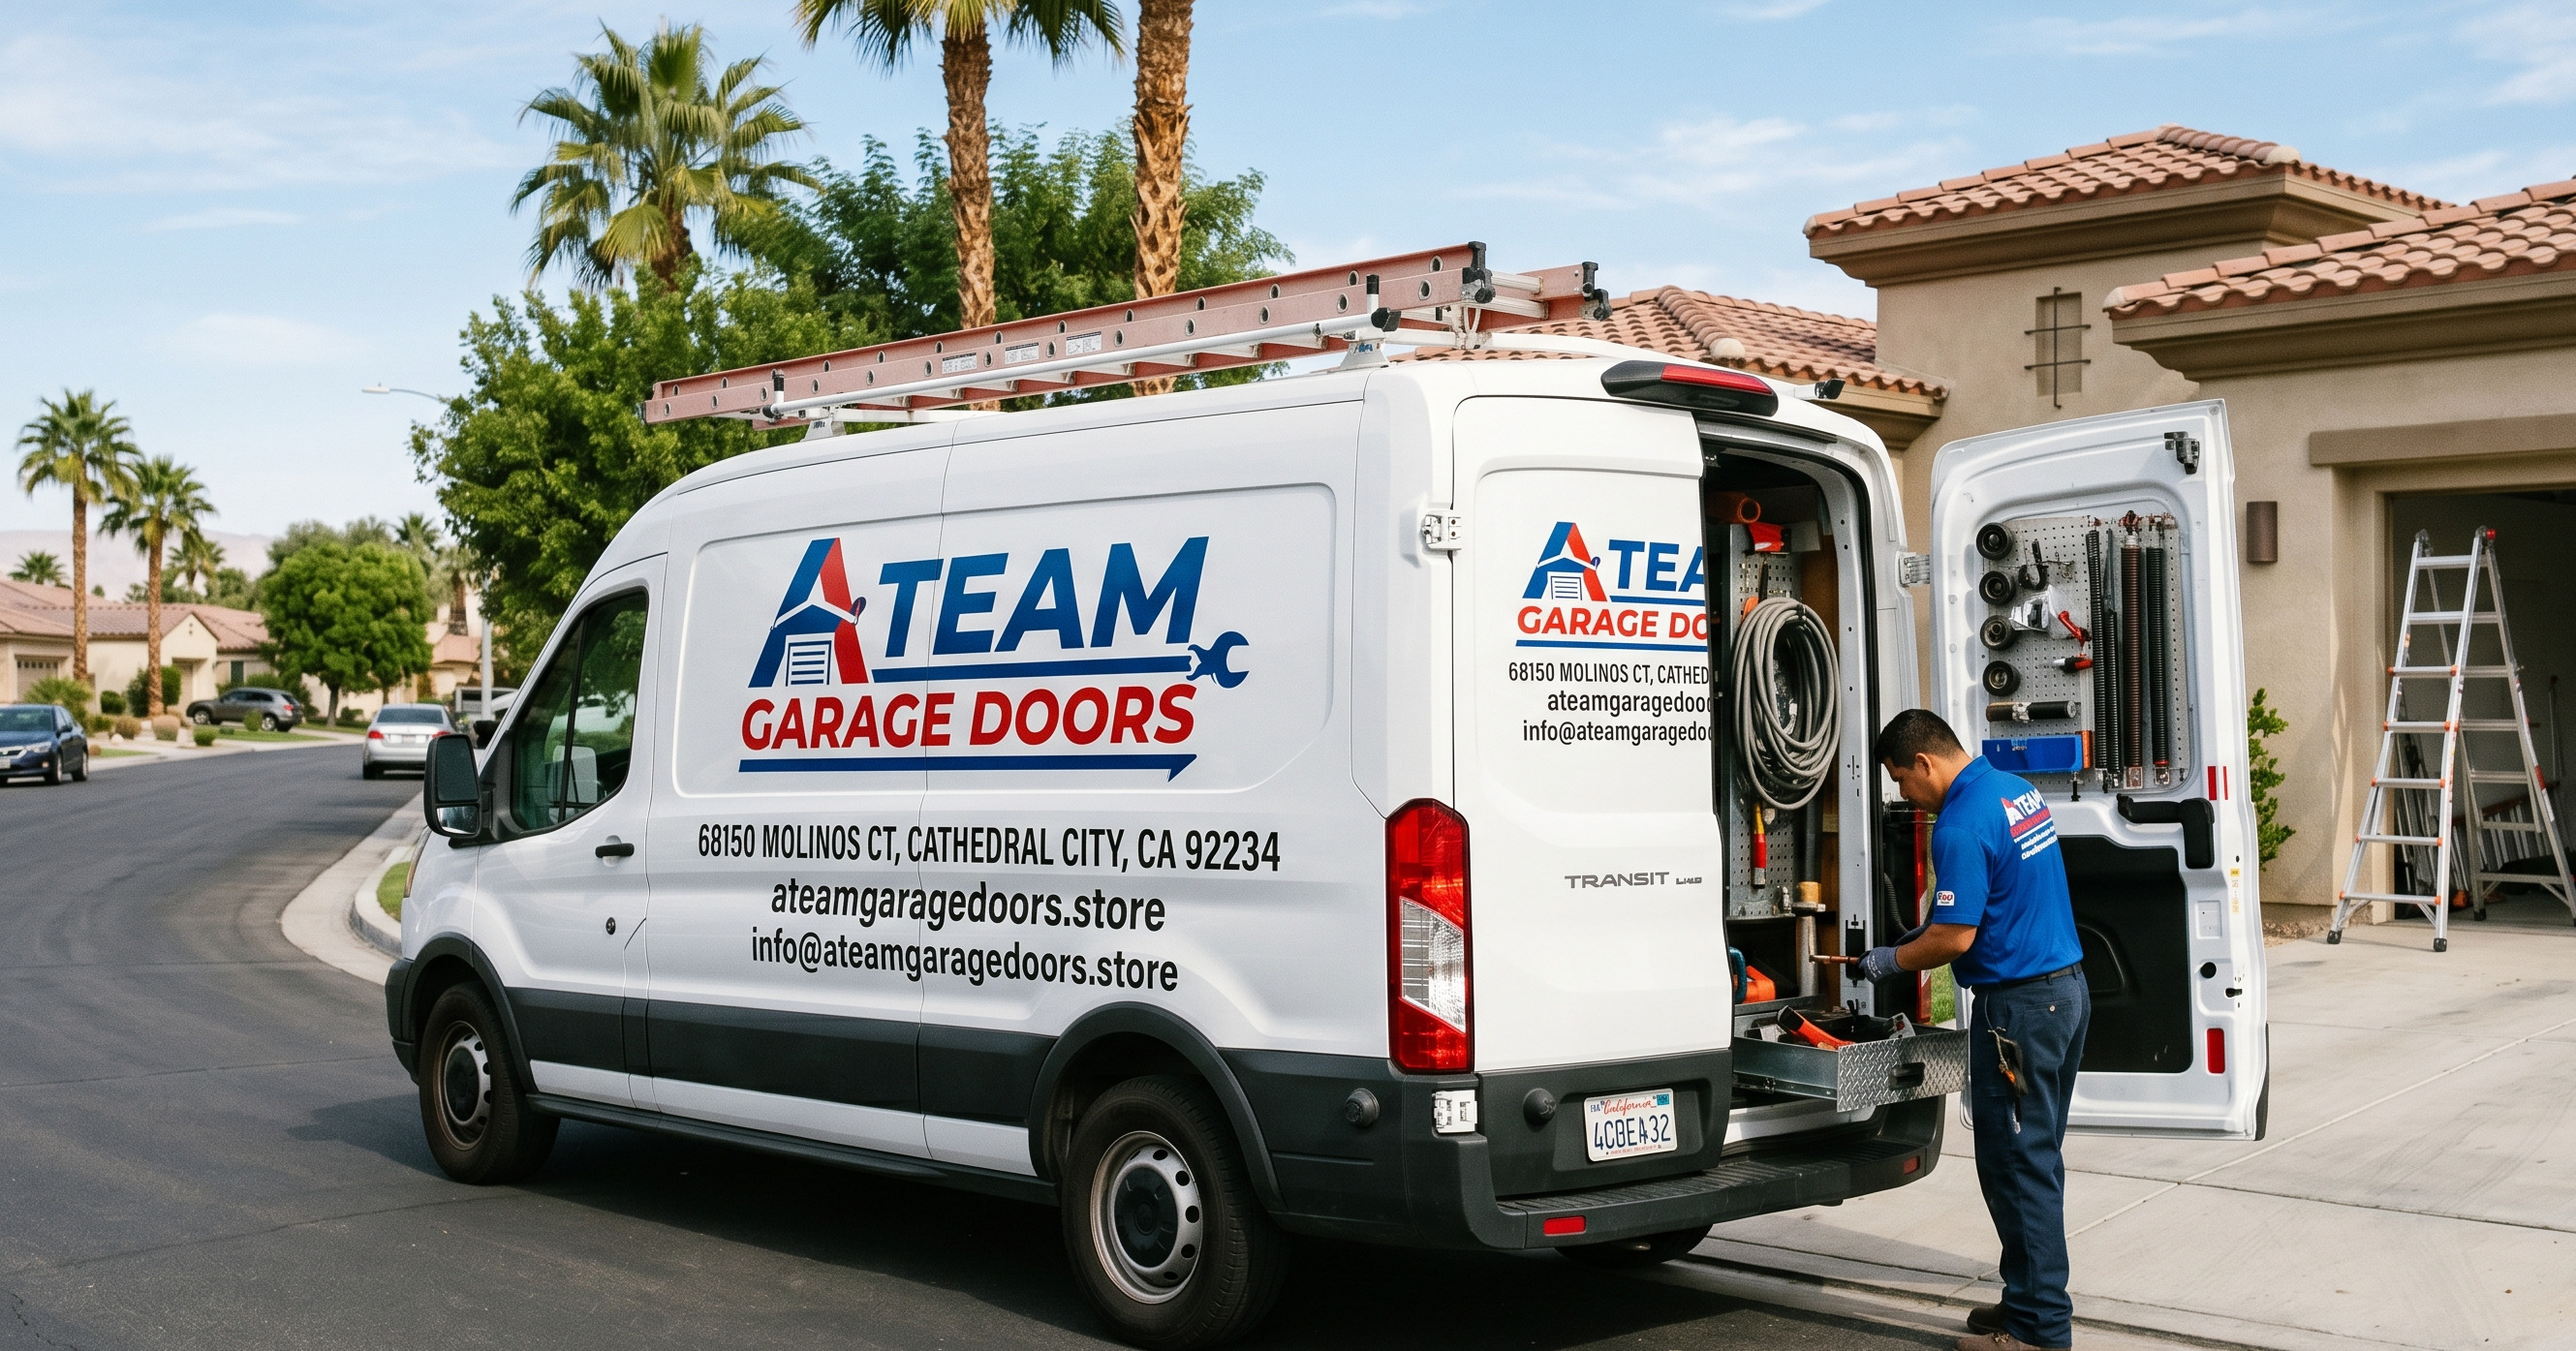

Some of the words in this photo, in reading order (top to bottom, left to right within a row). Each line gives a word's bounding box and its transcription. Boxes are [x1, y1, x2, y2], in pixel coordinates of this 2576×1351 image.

[1517, 605, 1660, 638] GARAGE
[1508, 661, 1555, 682] 68150
[1560, 662, 1629, 683] MOLINOS
[1632, 663, 1653, 686] CT,
[741, 691, 955, 752] GARAGE
[969, 683, 1197, 747] DOORS
[1523, 720, 1712, 747] info@ateamgaragedo
[698, 823, 756, 858] 68150
[762, 824, 861, 861] MOLINOS
[867, 825, 901, 867] CT,
[907, 825, 1054, 866] CATHEDRAL
[1062, 827, 1129, 874] CITY,
[1137, 828, 1177, 870] CA
[1185, 829, 1281, 872] 92234
[1564, 871, 1670, 889] TRANSIT
[771, 877, 1165, 932] ateamgaragedoors.store
[752, 926, 1178, 992] info@ateamgaragedoors.store
